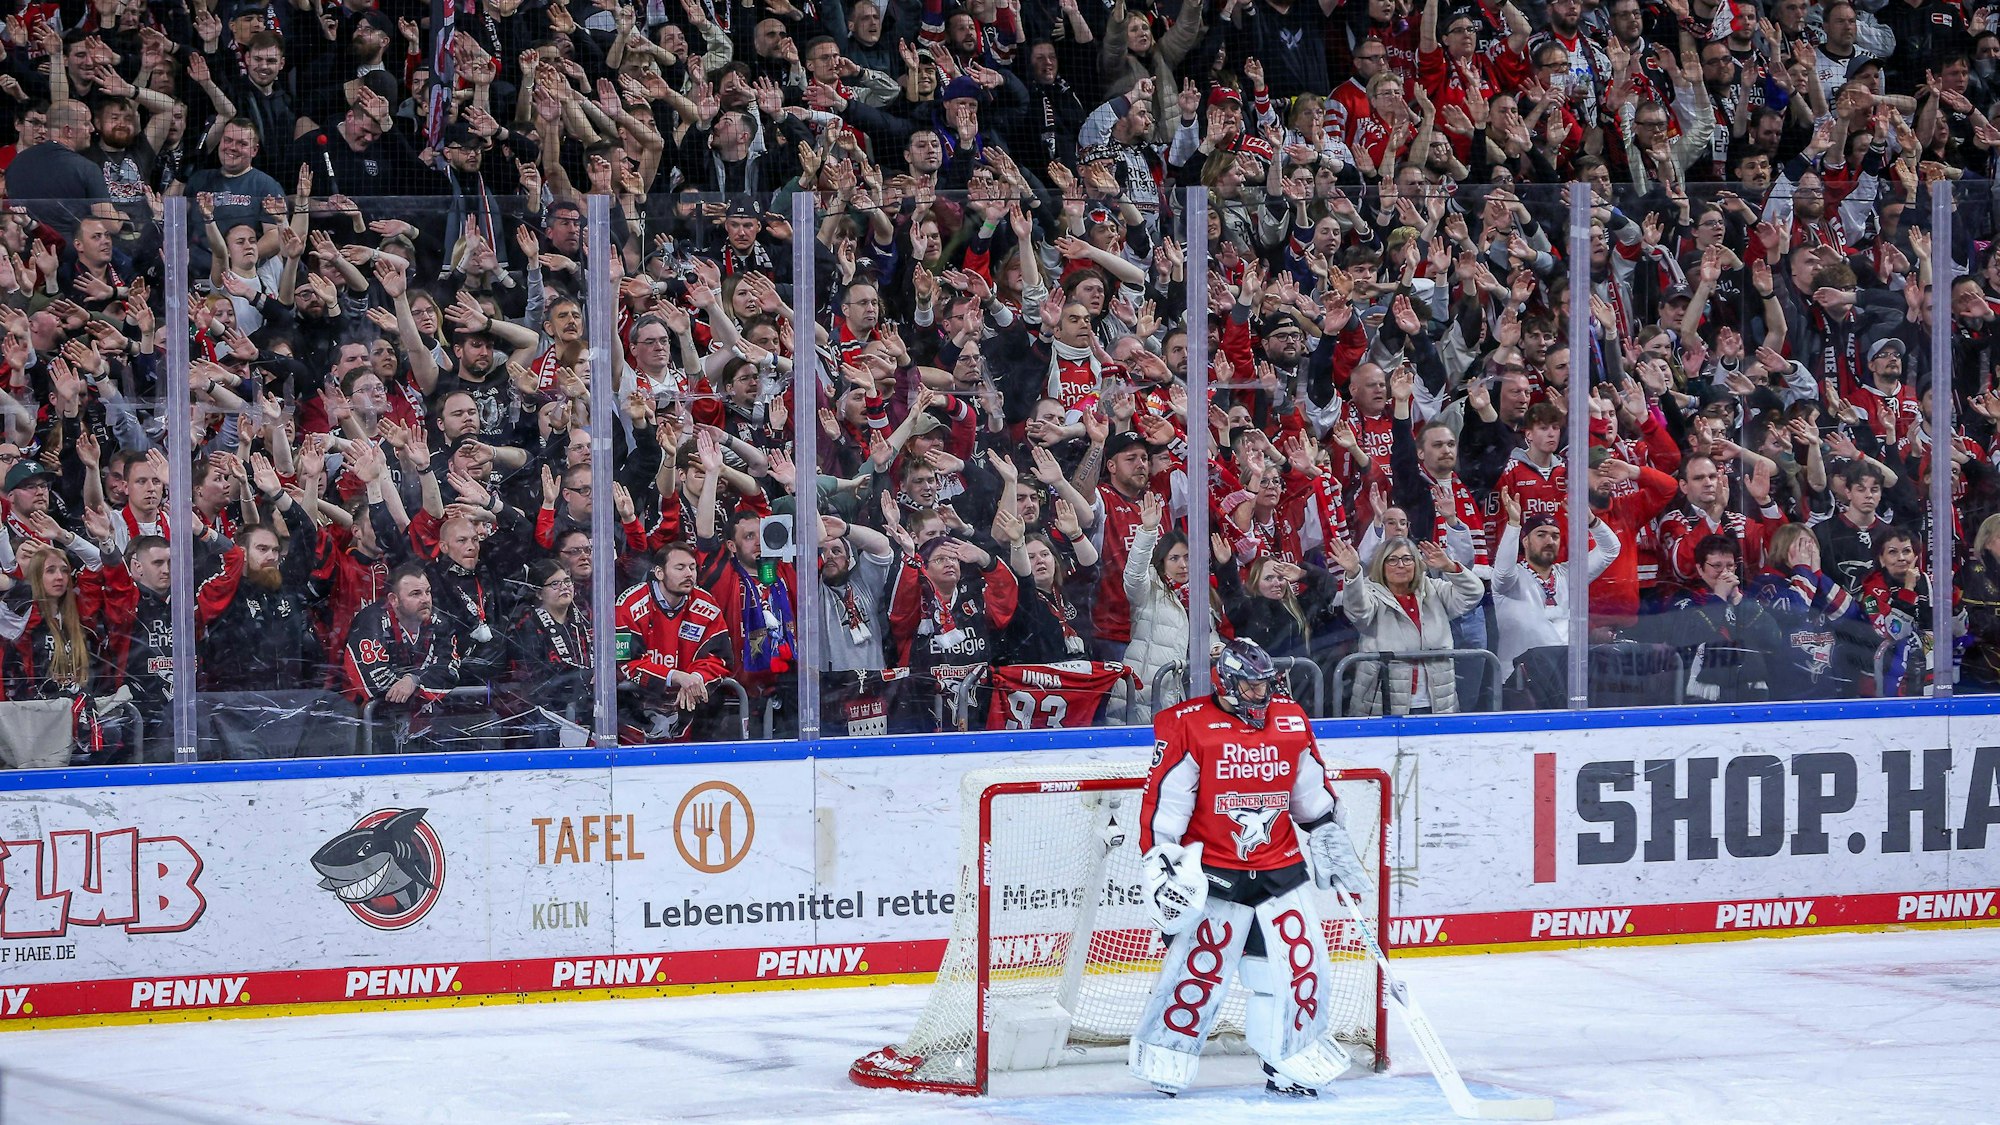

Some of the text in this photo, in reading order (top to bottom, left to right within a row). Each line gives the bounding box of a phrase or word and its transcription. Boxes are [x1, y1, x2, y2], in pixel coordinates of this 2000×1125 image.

[692, 602, 716, 618] HIT
[359, 638, 390, 664] 82
[1005, 689, 1068, 729] 93
[1216, 759, 1291, 782] Energie
[1223, 743, 1279, 763] Rhein
[1263, 793, 1288, 809] HAIE
[531, 813, 645, 865] TAFEL
[0, 825, 207, 940] LUB
[532, 896, 589, 931] KÖLN
[643, 889, 864, 929] Lebensmittel
[15, 945, 76, 962] HAIE.DE
[1271, 908, 1319, 1033] pape
[1163, 917, 1233, 1039] pape
